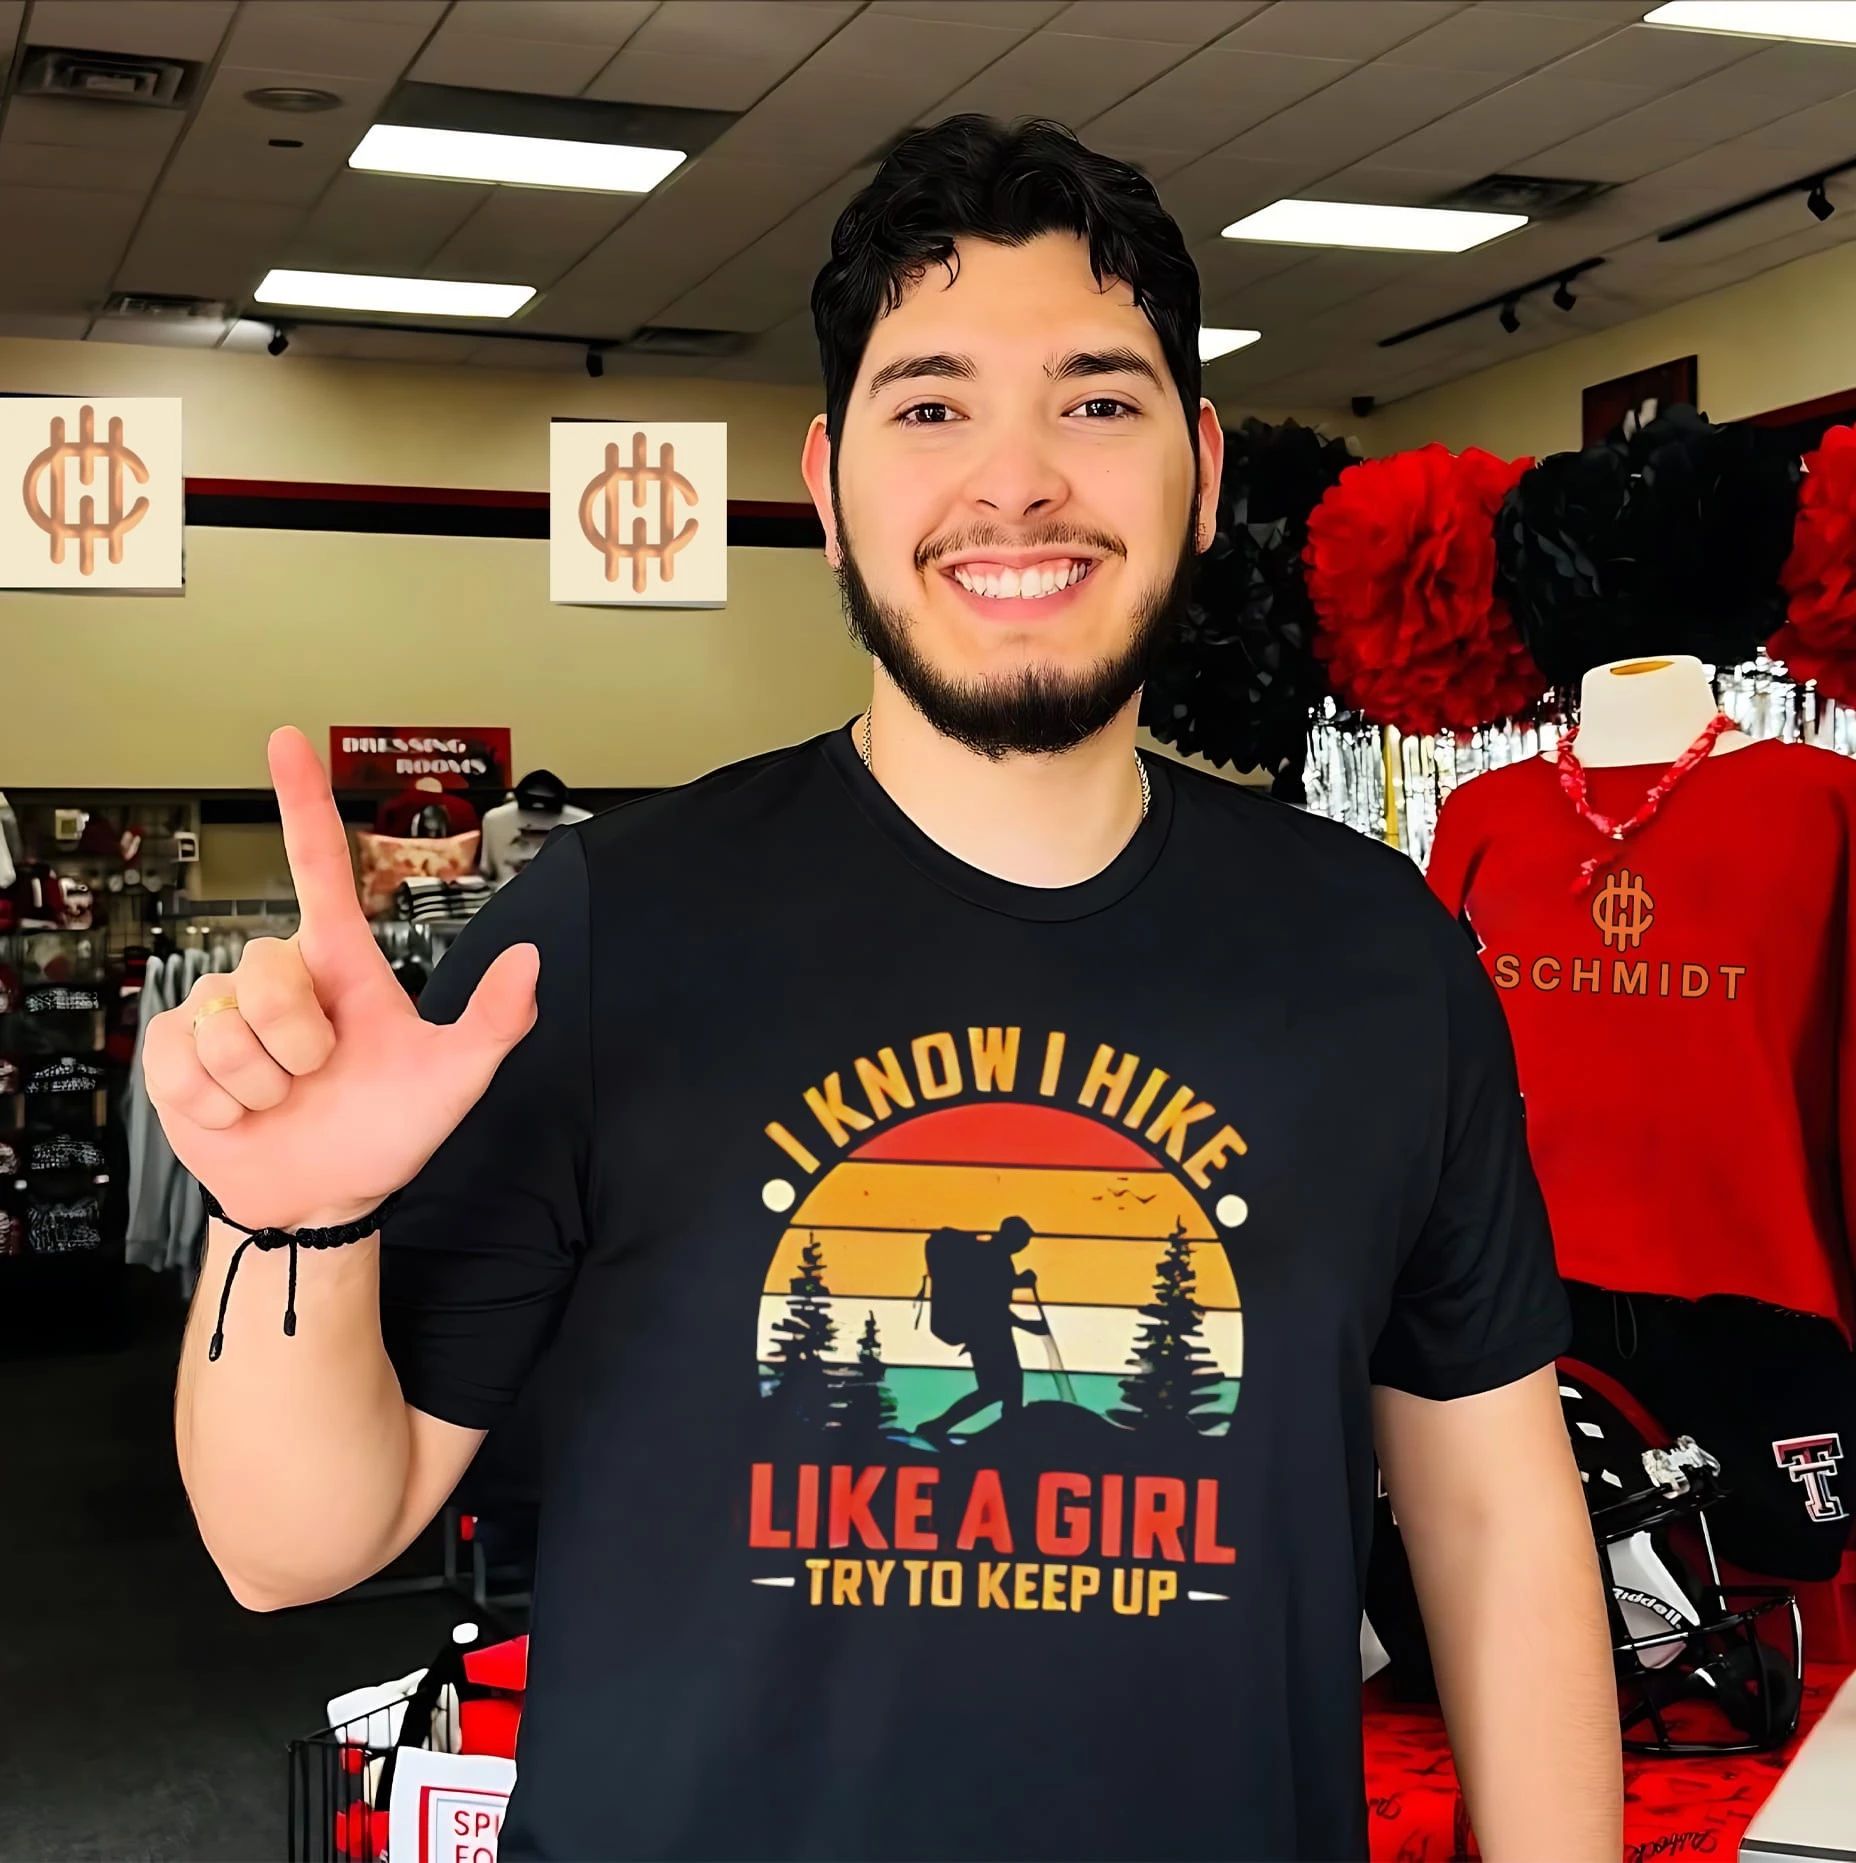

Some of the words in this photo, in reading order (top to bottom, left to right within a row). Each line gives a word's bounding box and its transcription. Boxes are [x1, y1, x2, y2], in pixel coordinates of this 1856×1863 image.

[396, 758, 487, 774] ROOMS
[1493, 954, 1747, 1000] SCHMIDT
[764, 1121, 821, 1174] I
[803, 1026, 1021, 1148] KNOW
[1039, 1031, 1066, 1097] I
[1077, 1043, 1249, 1190] HIKE
[748, 1462, 940, 1551] LIKE
[956, 1468, 1014, 1554] A
[1035, 1471, 1237, 1565] GIRL
[804, 1558, 896, 1607] TRY
[902, 1559, 963, 1607] TO
[977, 1561, 1101, 1613] KEEP
[1112, 1567, 1178, 1617] UP
